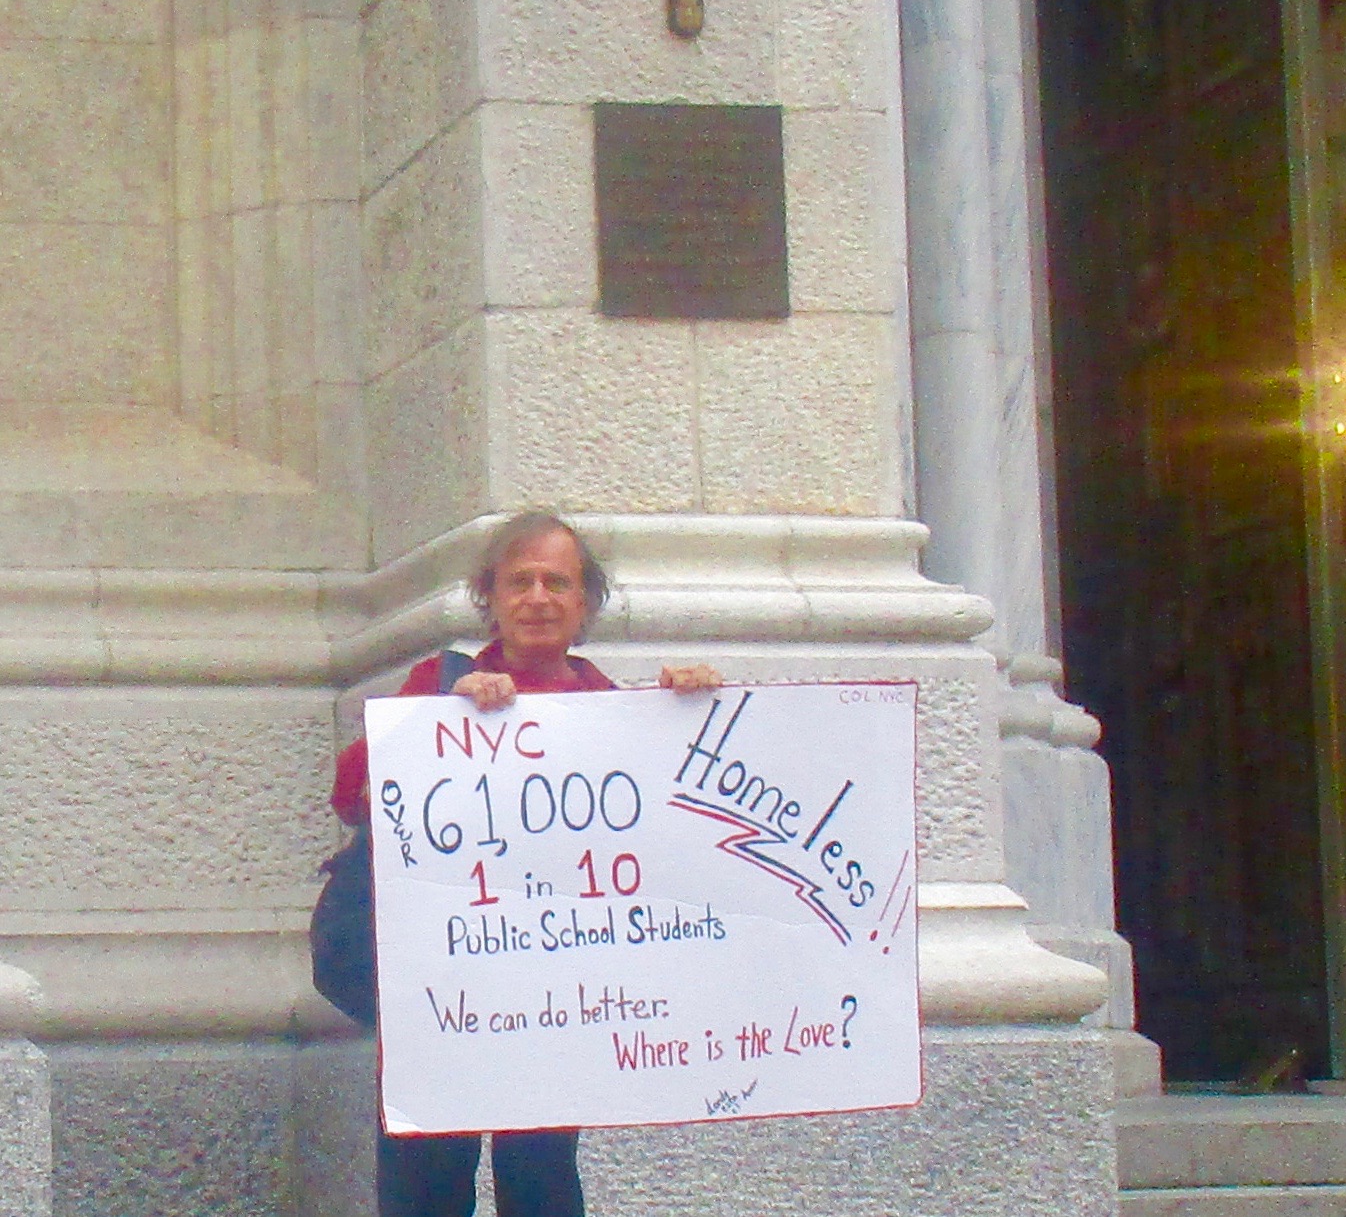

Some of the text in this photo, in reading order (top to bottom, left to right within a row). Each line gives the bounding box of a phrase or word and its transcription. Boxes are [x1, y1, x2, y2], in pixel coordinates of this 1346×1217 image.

[436, 717, 545, 763] NYC
[423, 770, 641, 857] 61,000
[470, 849, 641, 907] 1 in 10
[447, 903, 727, 956] Public School Students
[426, 983, 670, 1033] We can do better.
[612, 994, 858, 1071] Where is the Love?
